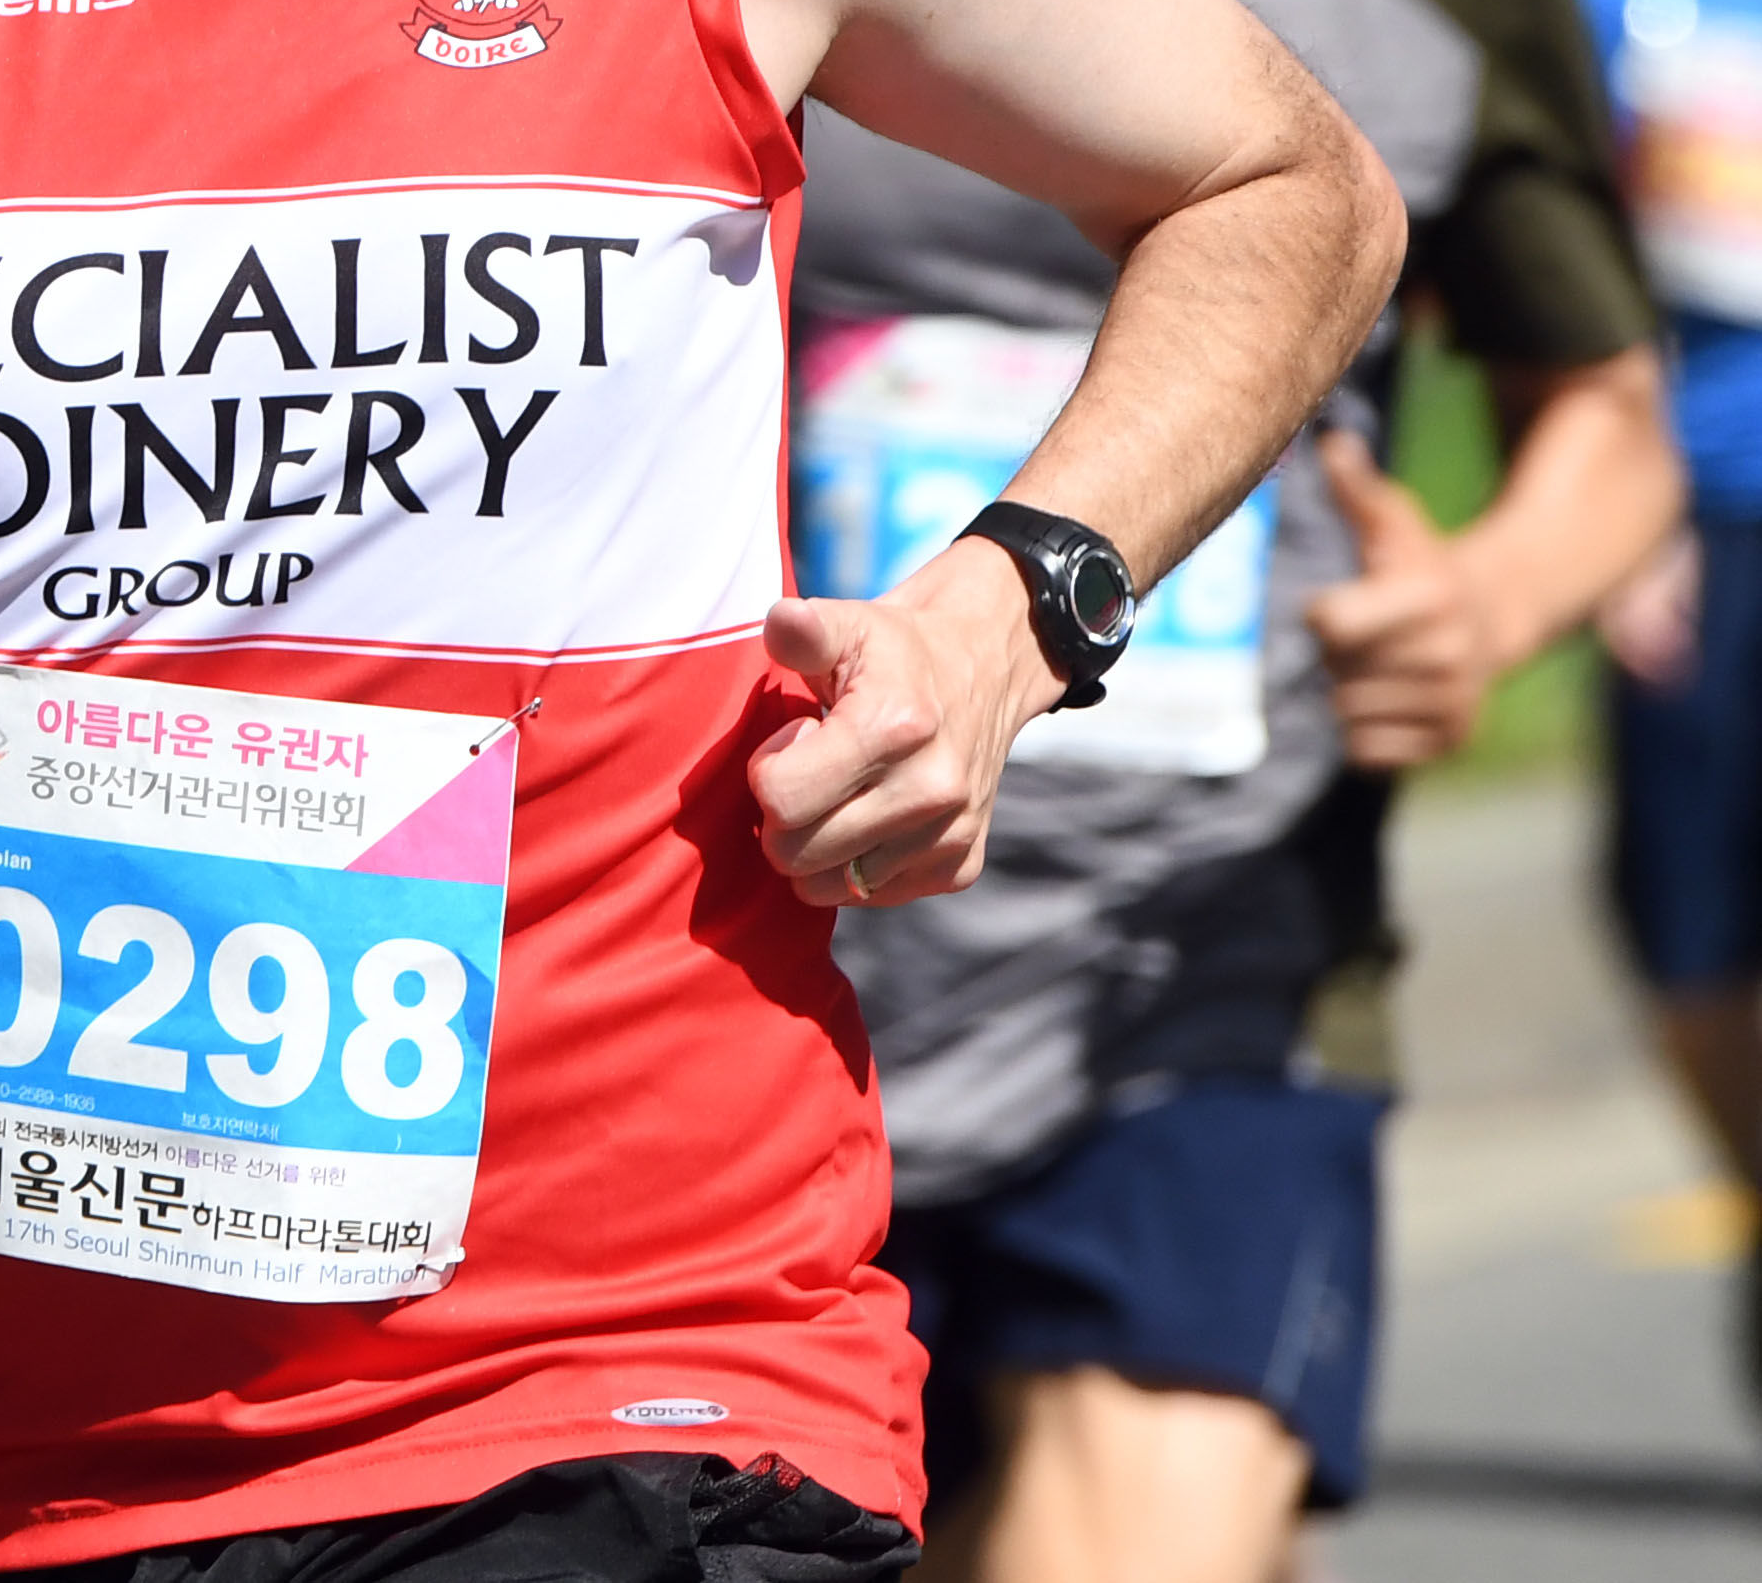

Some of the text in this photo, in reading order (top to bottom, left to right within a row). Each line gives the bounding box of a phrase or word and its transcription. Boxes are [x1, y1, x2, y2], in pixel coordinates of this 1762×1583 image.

[434, 35, 528, 64] DOIRE
[42, 552, 315, 622] GROUP
[36, 698, 370, 778] 아름다운 유권자
[26, 755, 366, 837] 중앙선거관리위원회
[4, 1218, 56, 1247] 17th
[64, 1227, 130, 1259] Seoul
[138, 1239, 244, 1274] Shinmun
[253, 1258, 306, 1285] Half
[318, 1263, 428, 1286] Marathon
[191, 1200, 433, 1254] 하프마라톤대회
